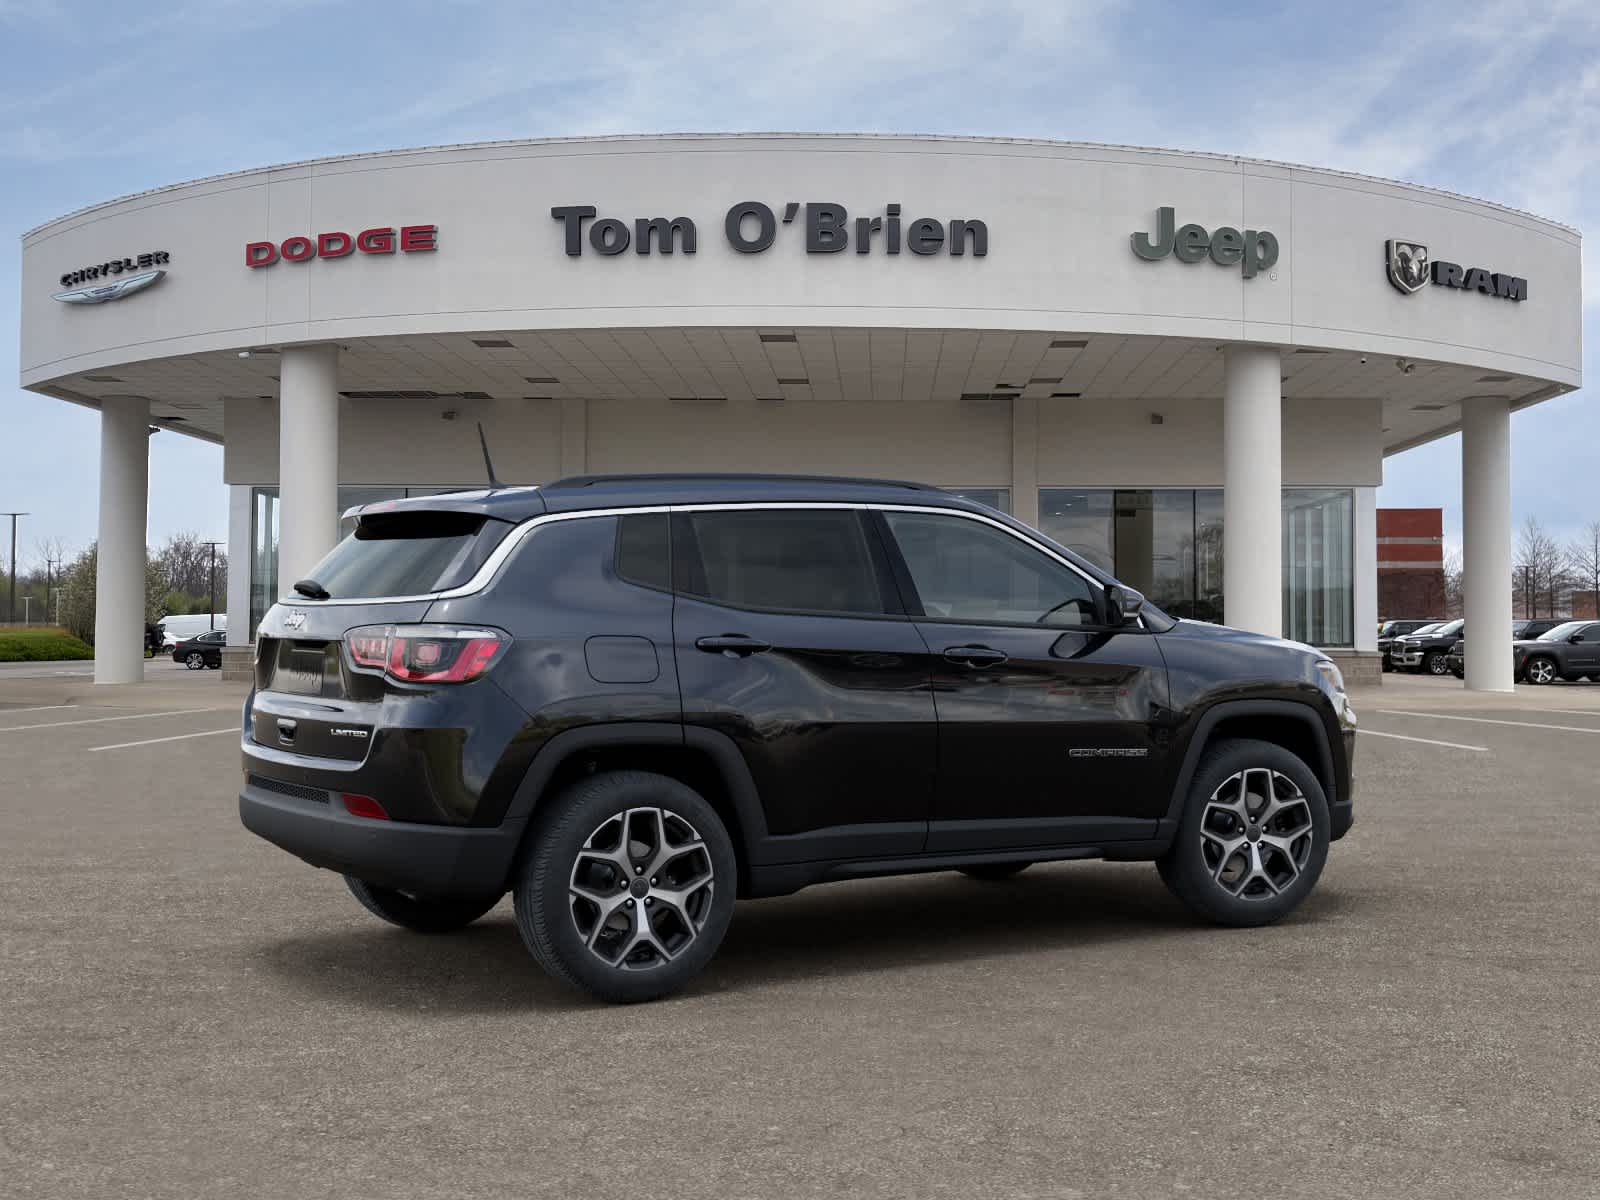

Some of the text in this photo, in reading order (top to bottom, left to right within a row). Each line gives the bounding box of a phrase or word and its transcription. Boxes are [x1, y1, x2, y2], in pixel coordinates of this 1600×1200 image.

[245, 224, 438, 269] DODGE
[551, 200, 988, 257] Tom O'Brien
[1130, 206, 1280, 279] Jeep
[60, 250, 170, 287] CHRYSLER
[1431, 260, 1528, 301] RAM
